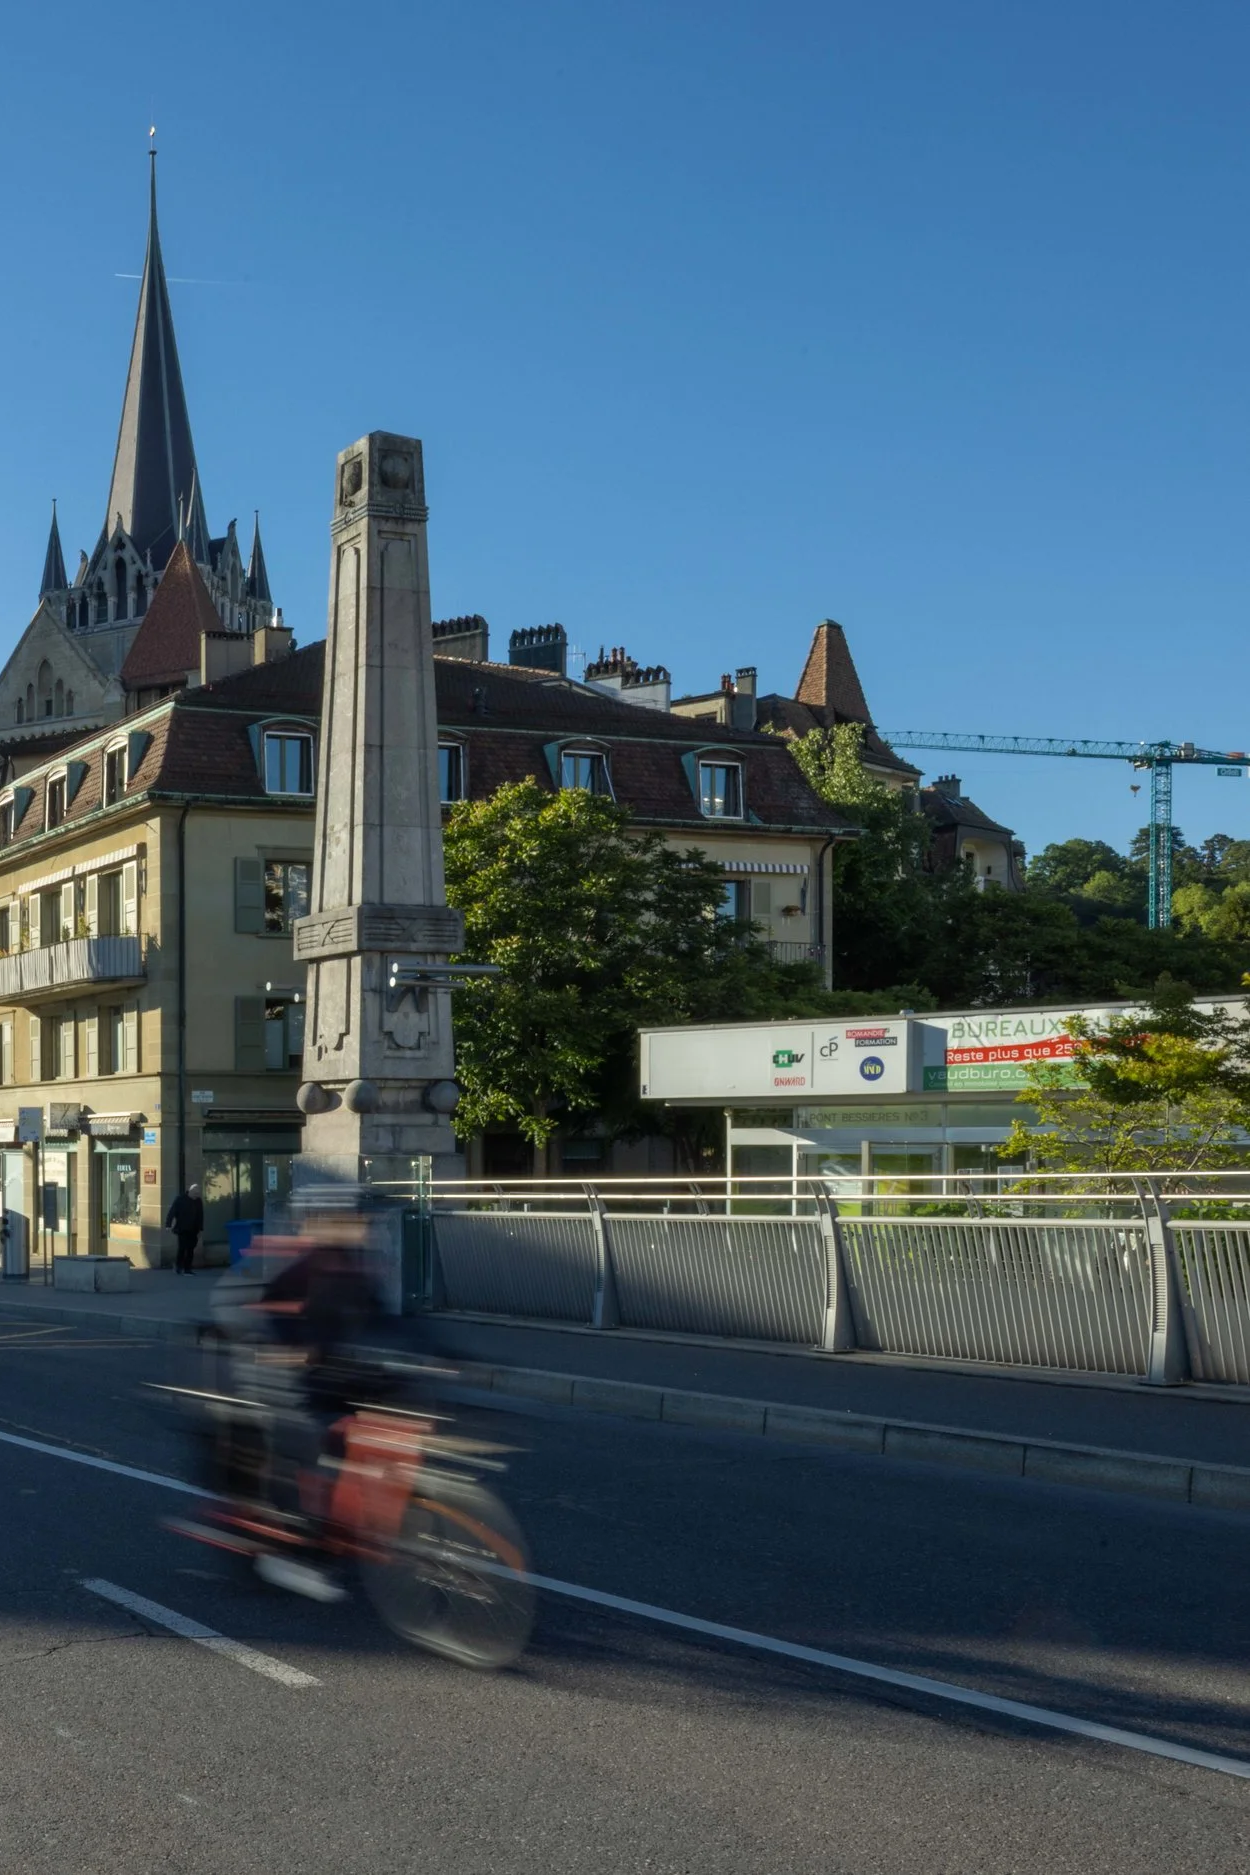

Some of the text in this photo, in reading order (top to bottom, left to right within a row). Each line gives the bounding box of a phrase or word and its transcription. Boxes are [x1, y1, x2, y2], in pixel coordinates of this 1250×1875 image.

[847, 1029, 884, 1038] ROMANDIE
[952, 1019, 1061, 1039] BUREAUX
[856, 1038, 896, 1047] FORMATION
[947, 1051, 984, 1062] Reste
[989, 1048, 1019, 1061] plus
[1024, 1046, 1050, 1059] que
[928, 1066, 1031, 1081] vaudburo.c
[774, 1077, 806, 1087] ONWARD
[810, 1112, 836, 1122] PONT
